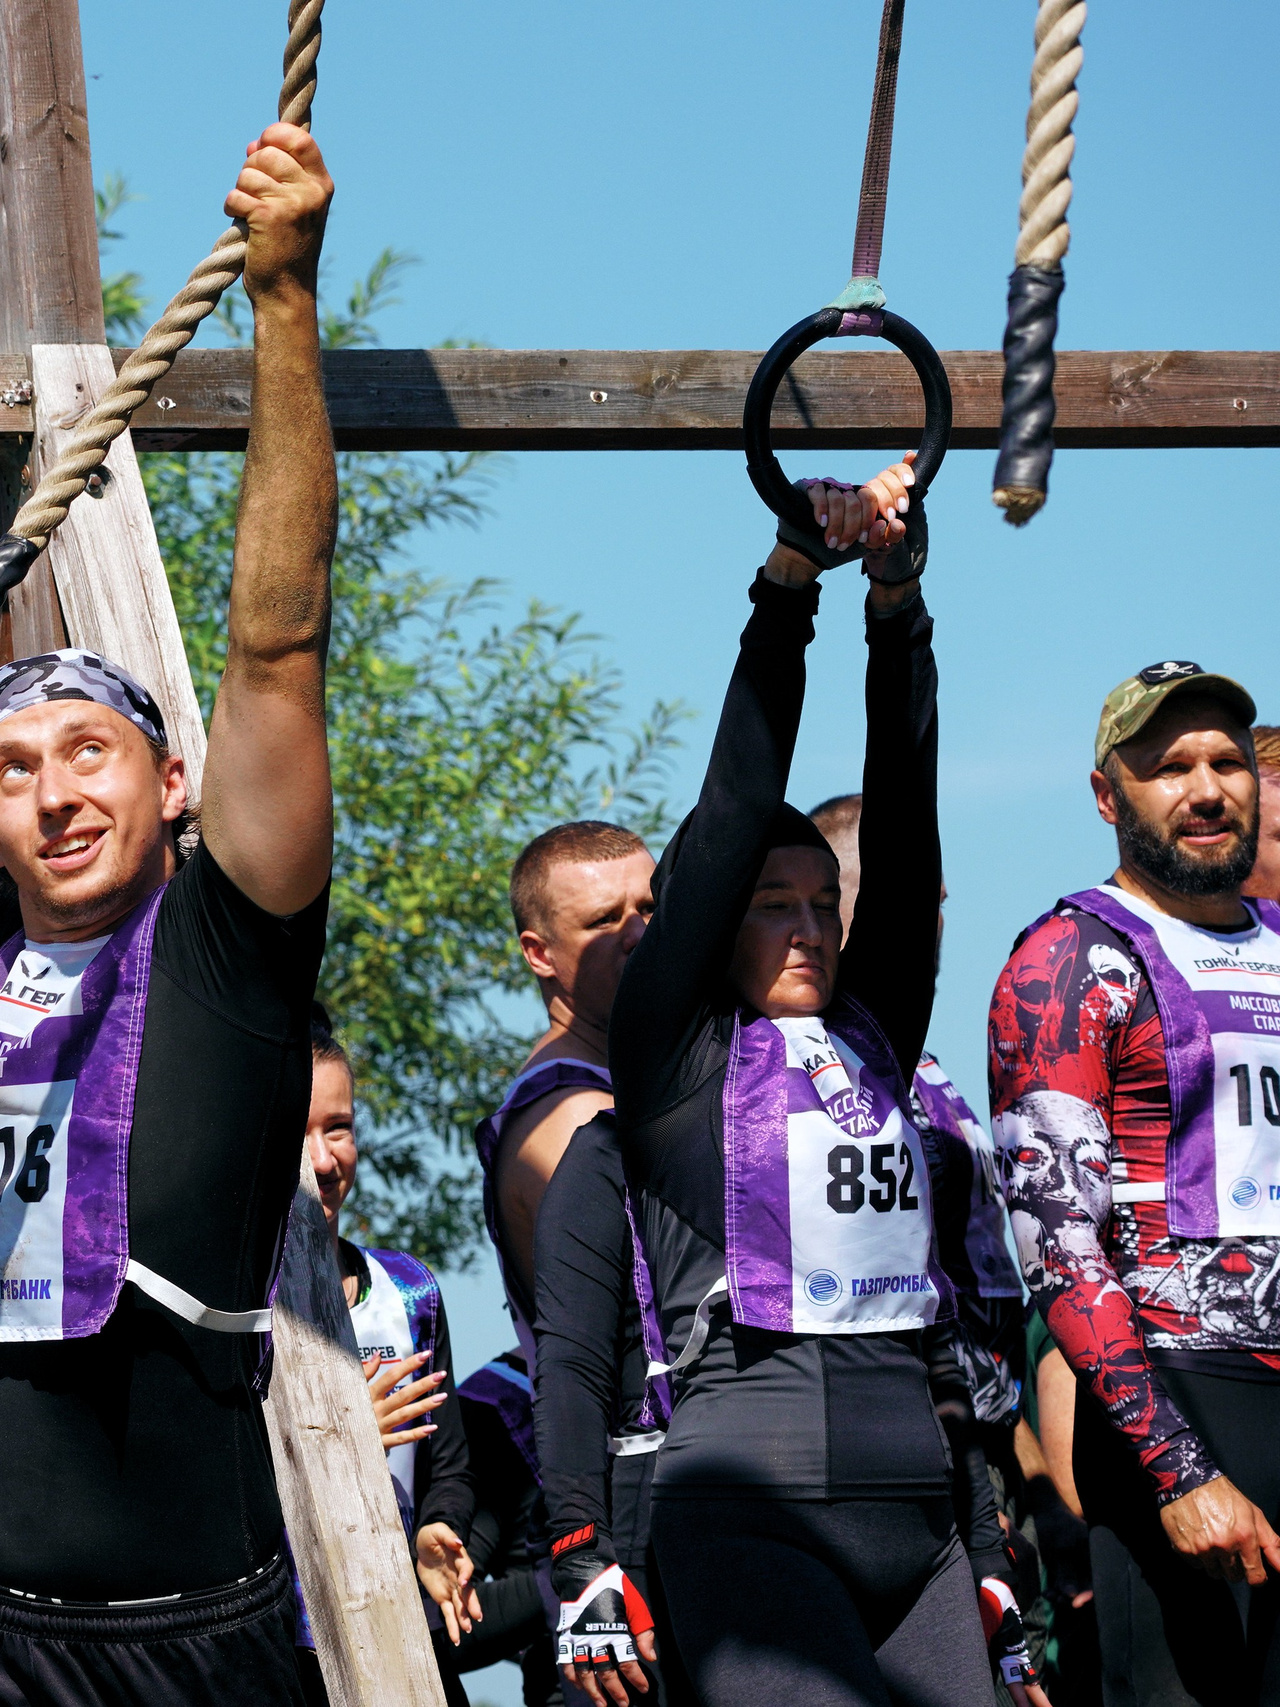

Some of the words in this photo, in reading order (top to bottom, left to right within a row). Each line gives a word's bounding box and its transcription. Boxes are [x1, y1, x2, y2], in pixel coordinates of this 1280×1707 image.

[1194, 957, 1239, 969] ГОНКА
[1253, 1014, 1280, 1032] СТАР
[826, 1141, 919, 1214] 852
[358, 1345, 397, 1360] ЕРОЕВ
